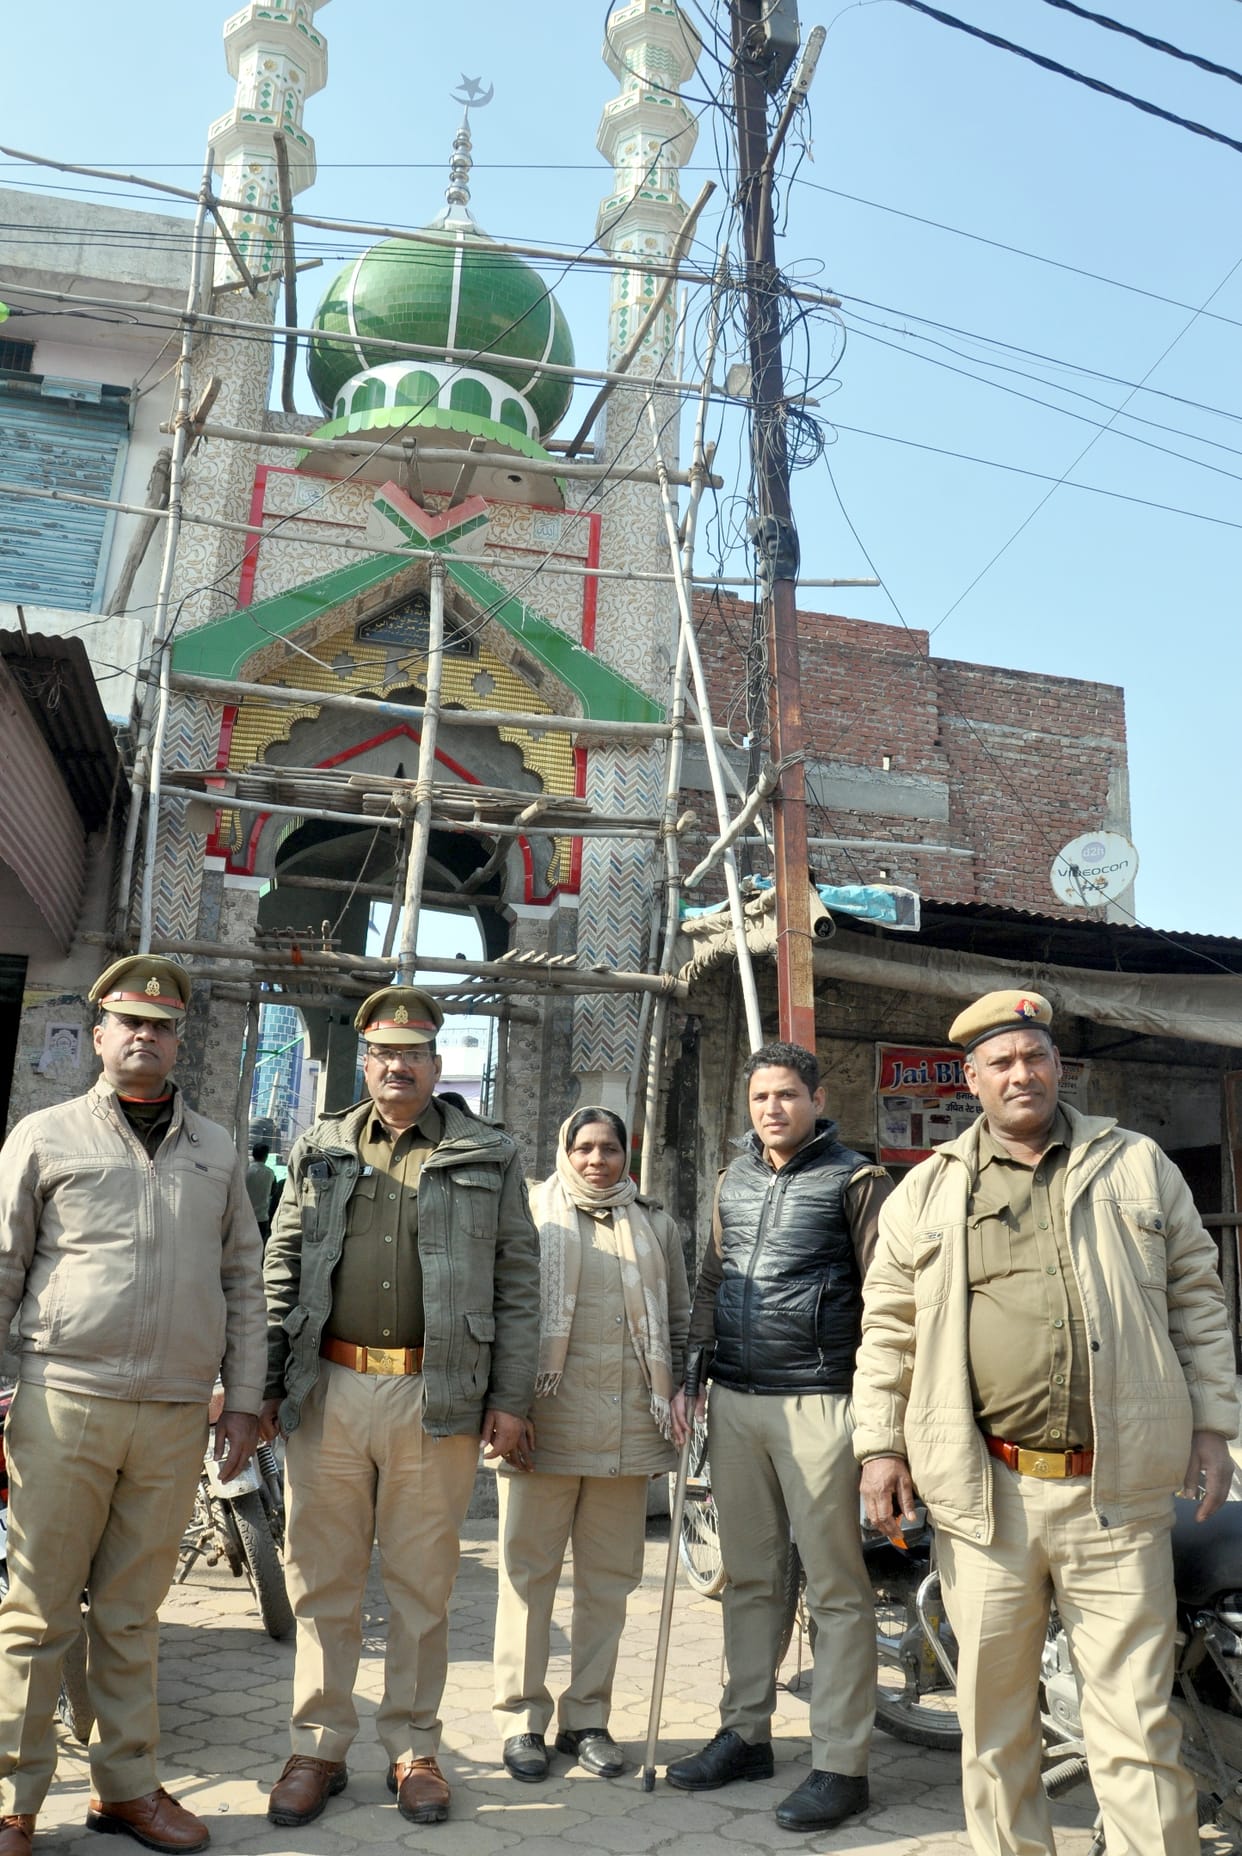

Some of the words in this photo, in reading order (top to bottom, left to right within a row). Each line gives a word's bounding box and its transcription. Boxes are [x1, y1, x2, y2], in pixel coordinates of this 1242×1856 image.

[1083, 847, 1105, 857] d2h
[891, 1061, 930, 1089] Jai
[934, 1061, 967, 1085] Bh
